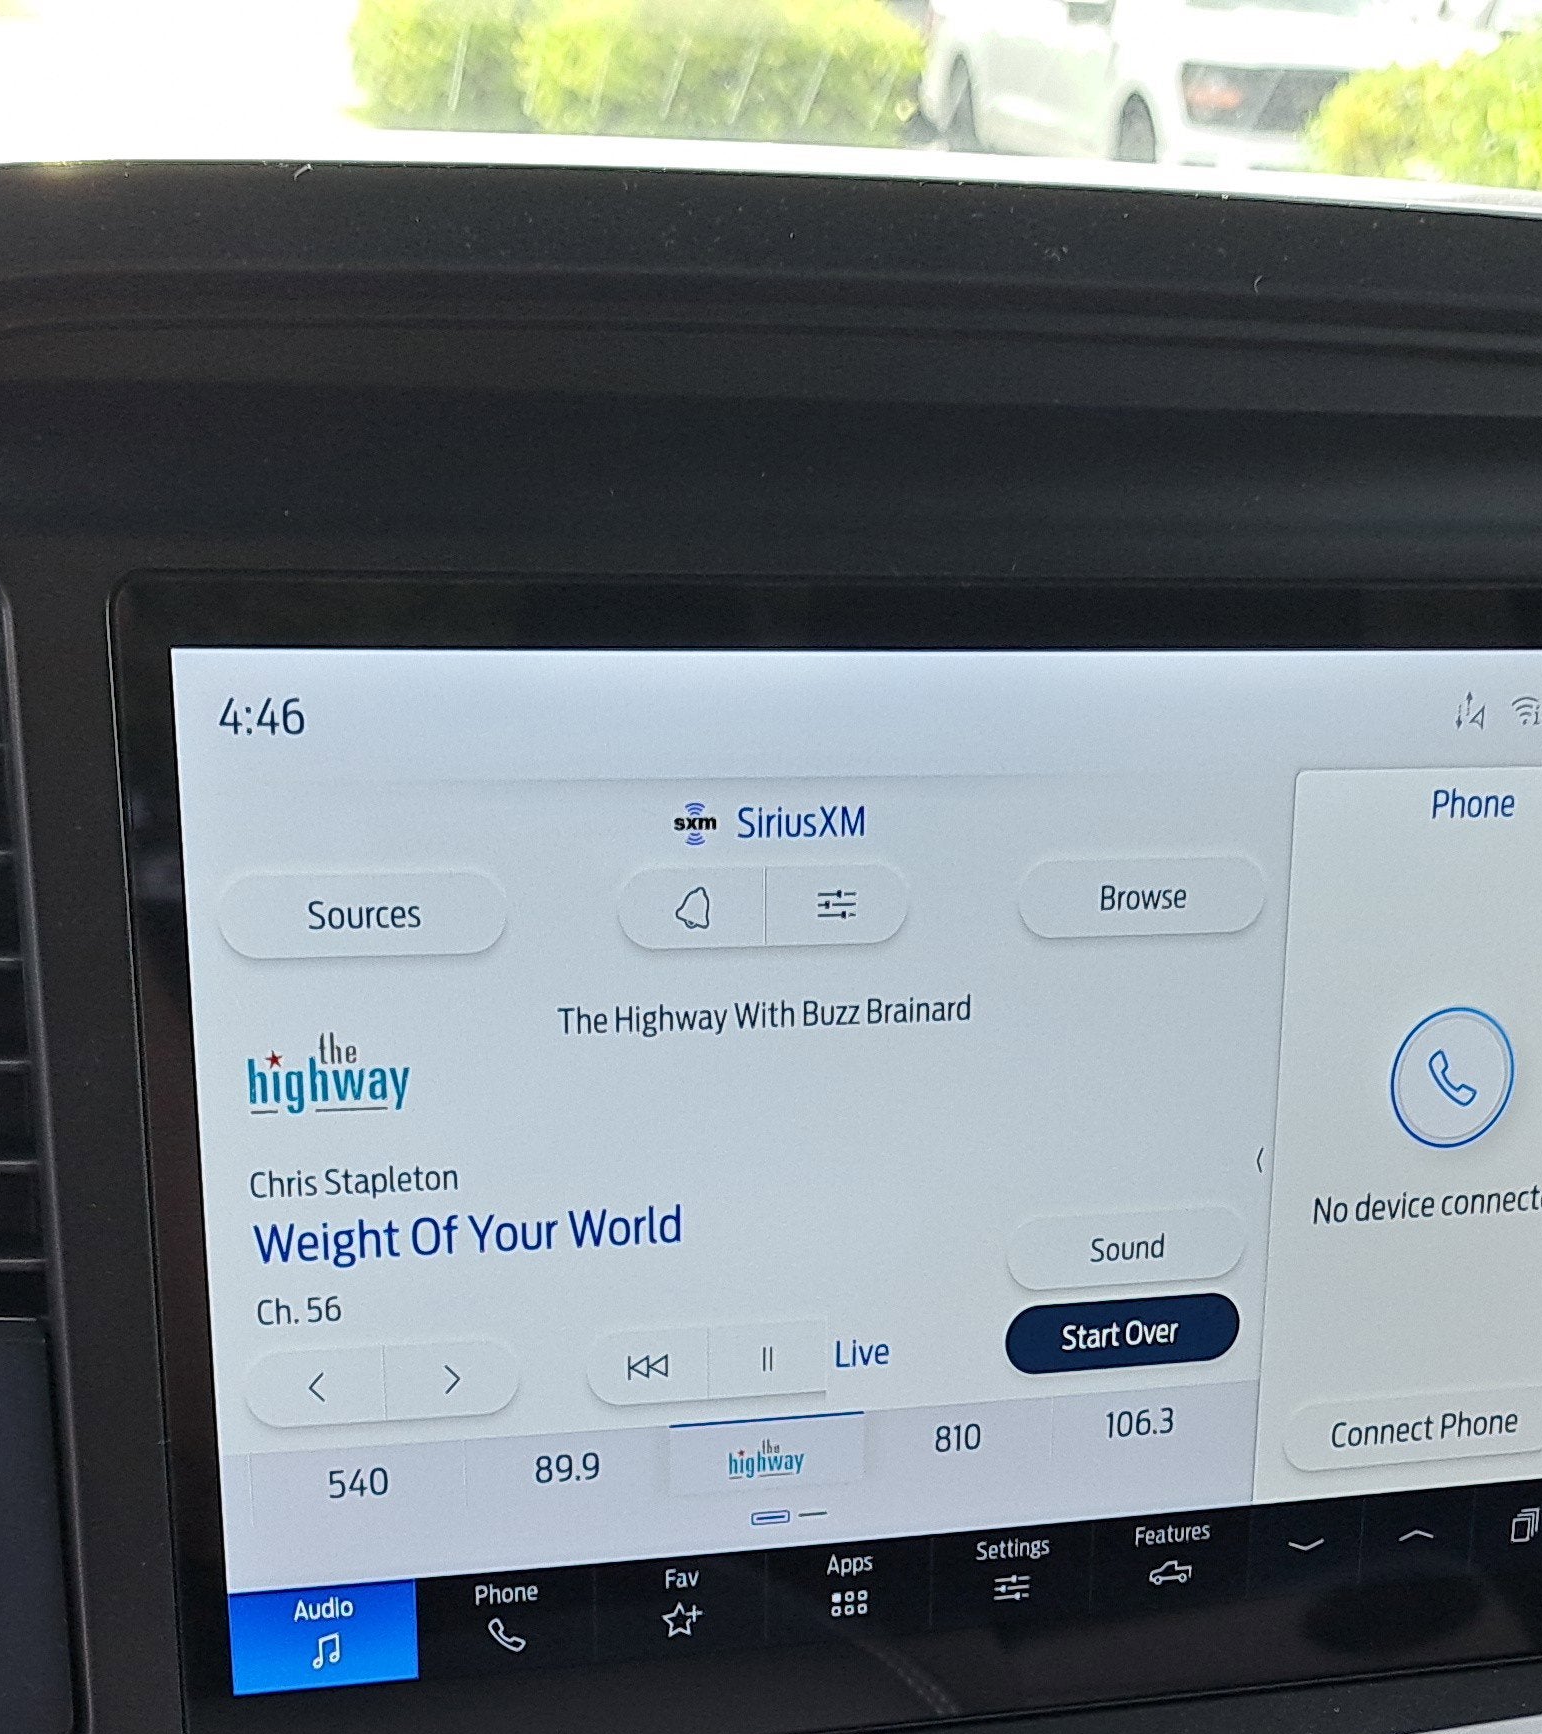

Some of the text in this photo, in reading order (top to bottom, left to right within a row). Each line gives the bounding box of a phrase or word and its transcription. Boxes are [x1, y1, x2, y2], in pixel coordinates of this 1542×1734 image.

[218, 698, 306, 737] 4:46
[1431, 790, 1515, 819] Phone
[673, 815, 717, 831] sxm
[737, 805, 866, 840] SiriusXM
[1100, 884, 1187, 911] Browse
[307, 900, 421, 930] Sources
[558, 995, 972, 1038] The Highway With Buzz Brainard
[318, 1032, 358, 1065] the
[247, 1058, 410, 1114] highway
[250, 1165, 459, 1199] Chris Stapleton
[1312, 1196, 1349, 1225] No
[1355, 1191, 1434, 1220] device
[253, 1204, 683, 1268] Weight Of Your World
[1089, 1234, 1165, 1264] Sound
[257, 1297, 342, 1326] Ch. 56
[1061, 1319, 1178, 1351] Start Over
[835, 1340, 890, 1369] Live
[934, 1424, 981, 1452] 810
[1106, 1408, 1174, 1438] 106.3
[1331, 1410, 1518, 1448] Connect Phone
[534, 1453, 600, 1483] 89.9
[728, 1449, 805, 1479] highway
[328, 1468, 389, 1498] 540
[976, 1536, 1050, 1561] Settings
[1135, 1522, 1210, 1547] Features
[664, 1567, 699, 1590] Fav
[827, 1554, 873, 1578] Apps
[474, 1581, 538, 1604] Phone
[293, 1596, 354, 1622] Audio
